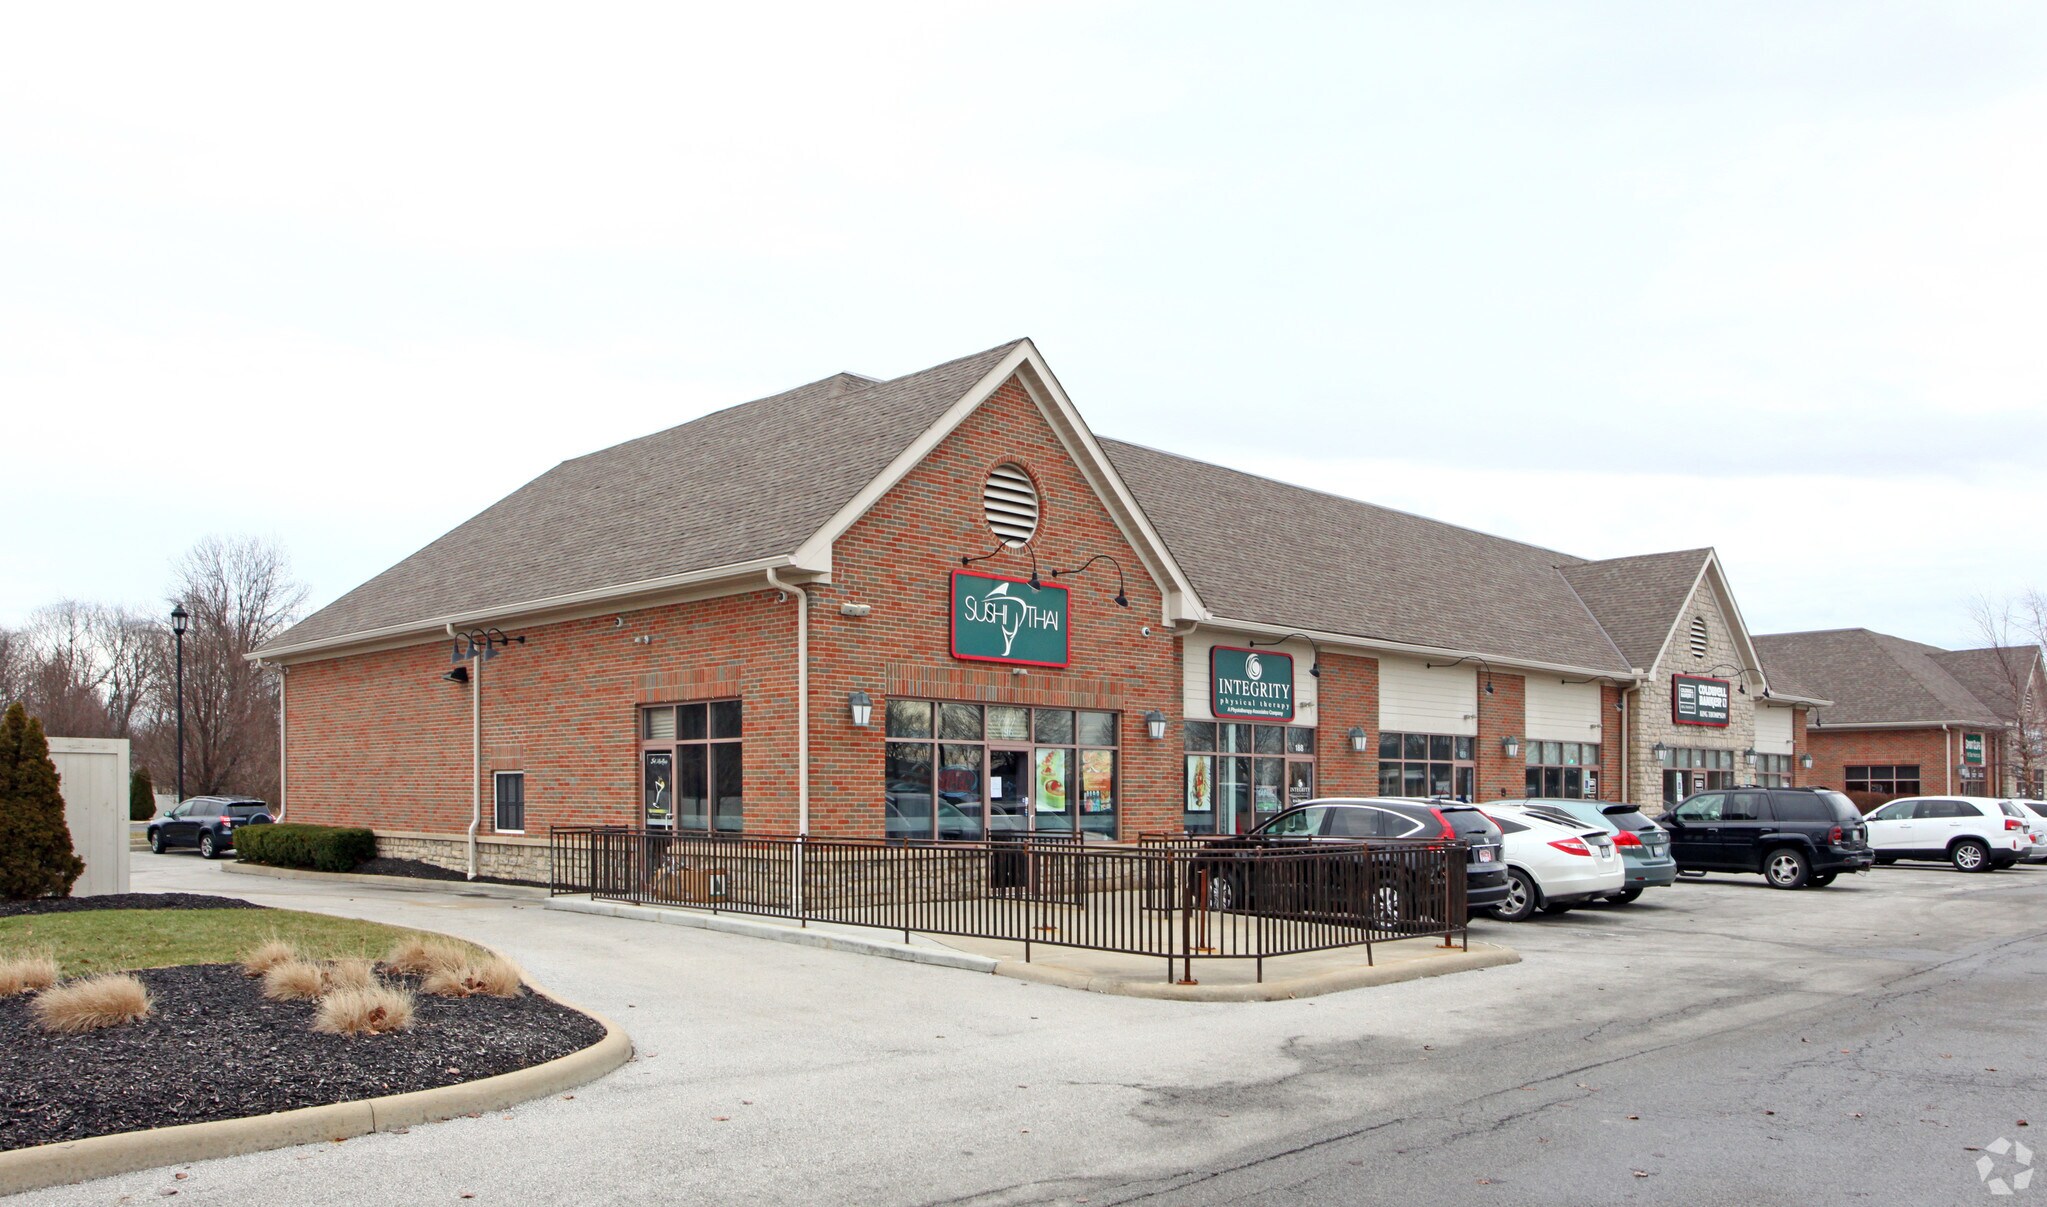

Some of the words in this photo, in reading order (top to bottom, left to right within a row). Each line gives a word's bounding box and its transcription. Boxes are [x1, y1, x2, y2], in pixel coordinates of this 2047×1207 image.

[1026, 605, 1059, 631] THAI
[1219, 678, 1290, 699] INTEGRITY
[1220, 698, 1255, 707] physical
[1260, 700, 1290, 710] therapy
